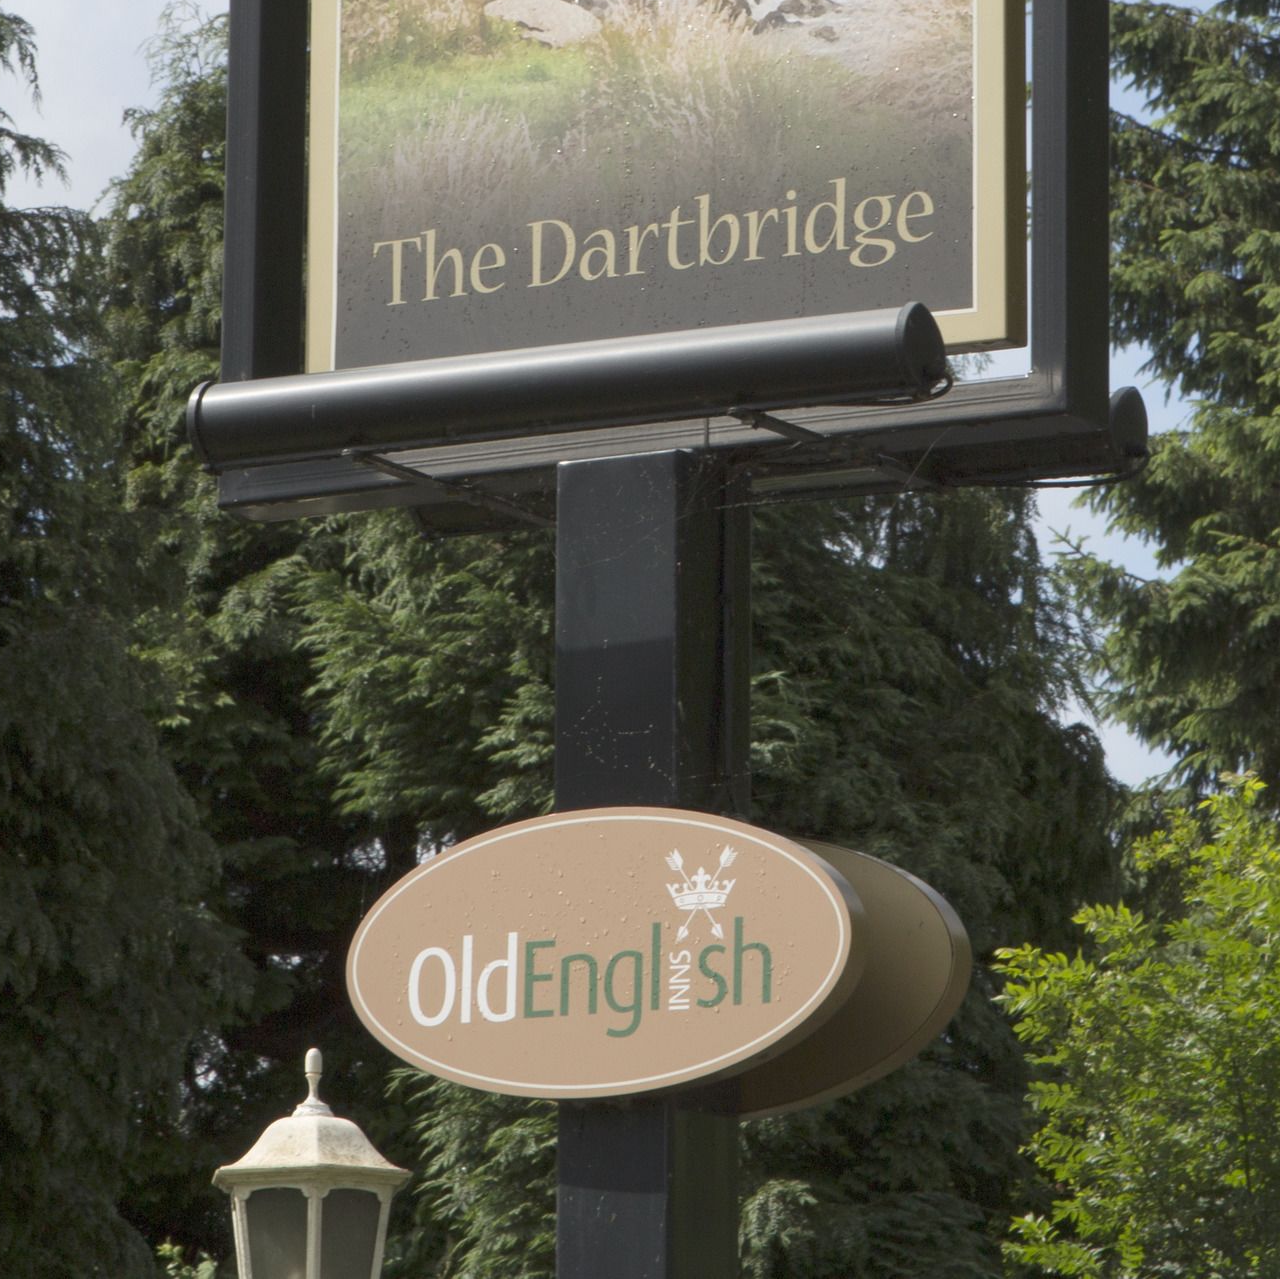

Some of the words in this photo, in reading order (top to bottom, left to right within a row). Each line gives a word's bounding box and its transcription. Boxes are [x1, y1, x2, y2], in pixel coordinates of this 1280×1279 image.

[373, 229, 507, 307] The
[526, 178, 936, 288] Dartbridge
[667, 949, 691, 1011] INNS
